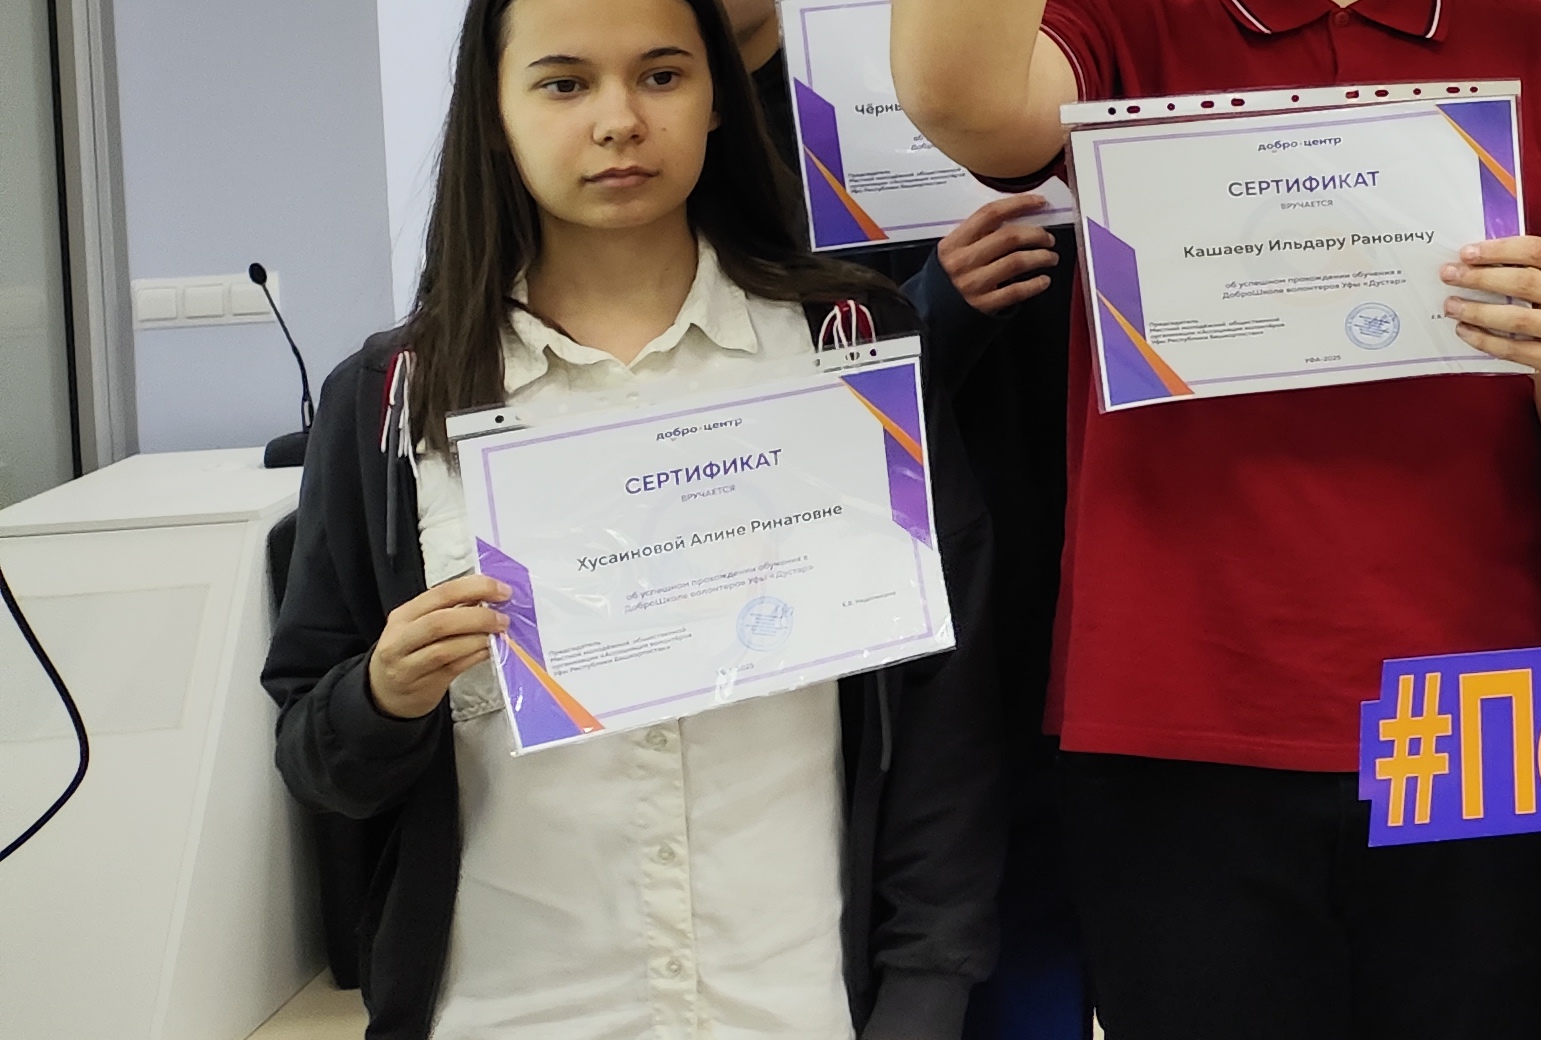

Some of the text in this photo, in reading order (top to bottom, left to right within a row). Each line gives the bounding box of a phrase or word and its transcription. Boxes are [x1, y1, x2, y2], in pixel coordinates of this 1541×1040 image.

[1228, 170, 1380, 197] СЕРТИФИКАТ
[1183, 230, 1435, 259] Кашаеву Ильдару Рановичу
[625, 448, 782, 495] СЕРТИФИКАТ
[577, 505, 843, 572] Хусаиновой Алине Ринатовне
